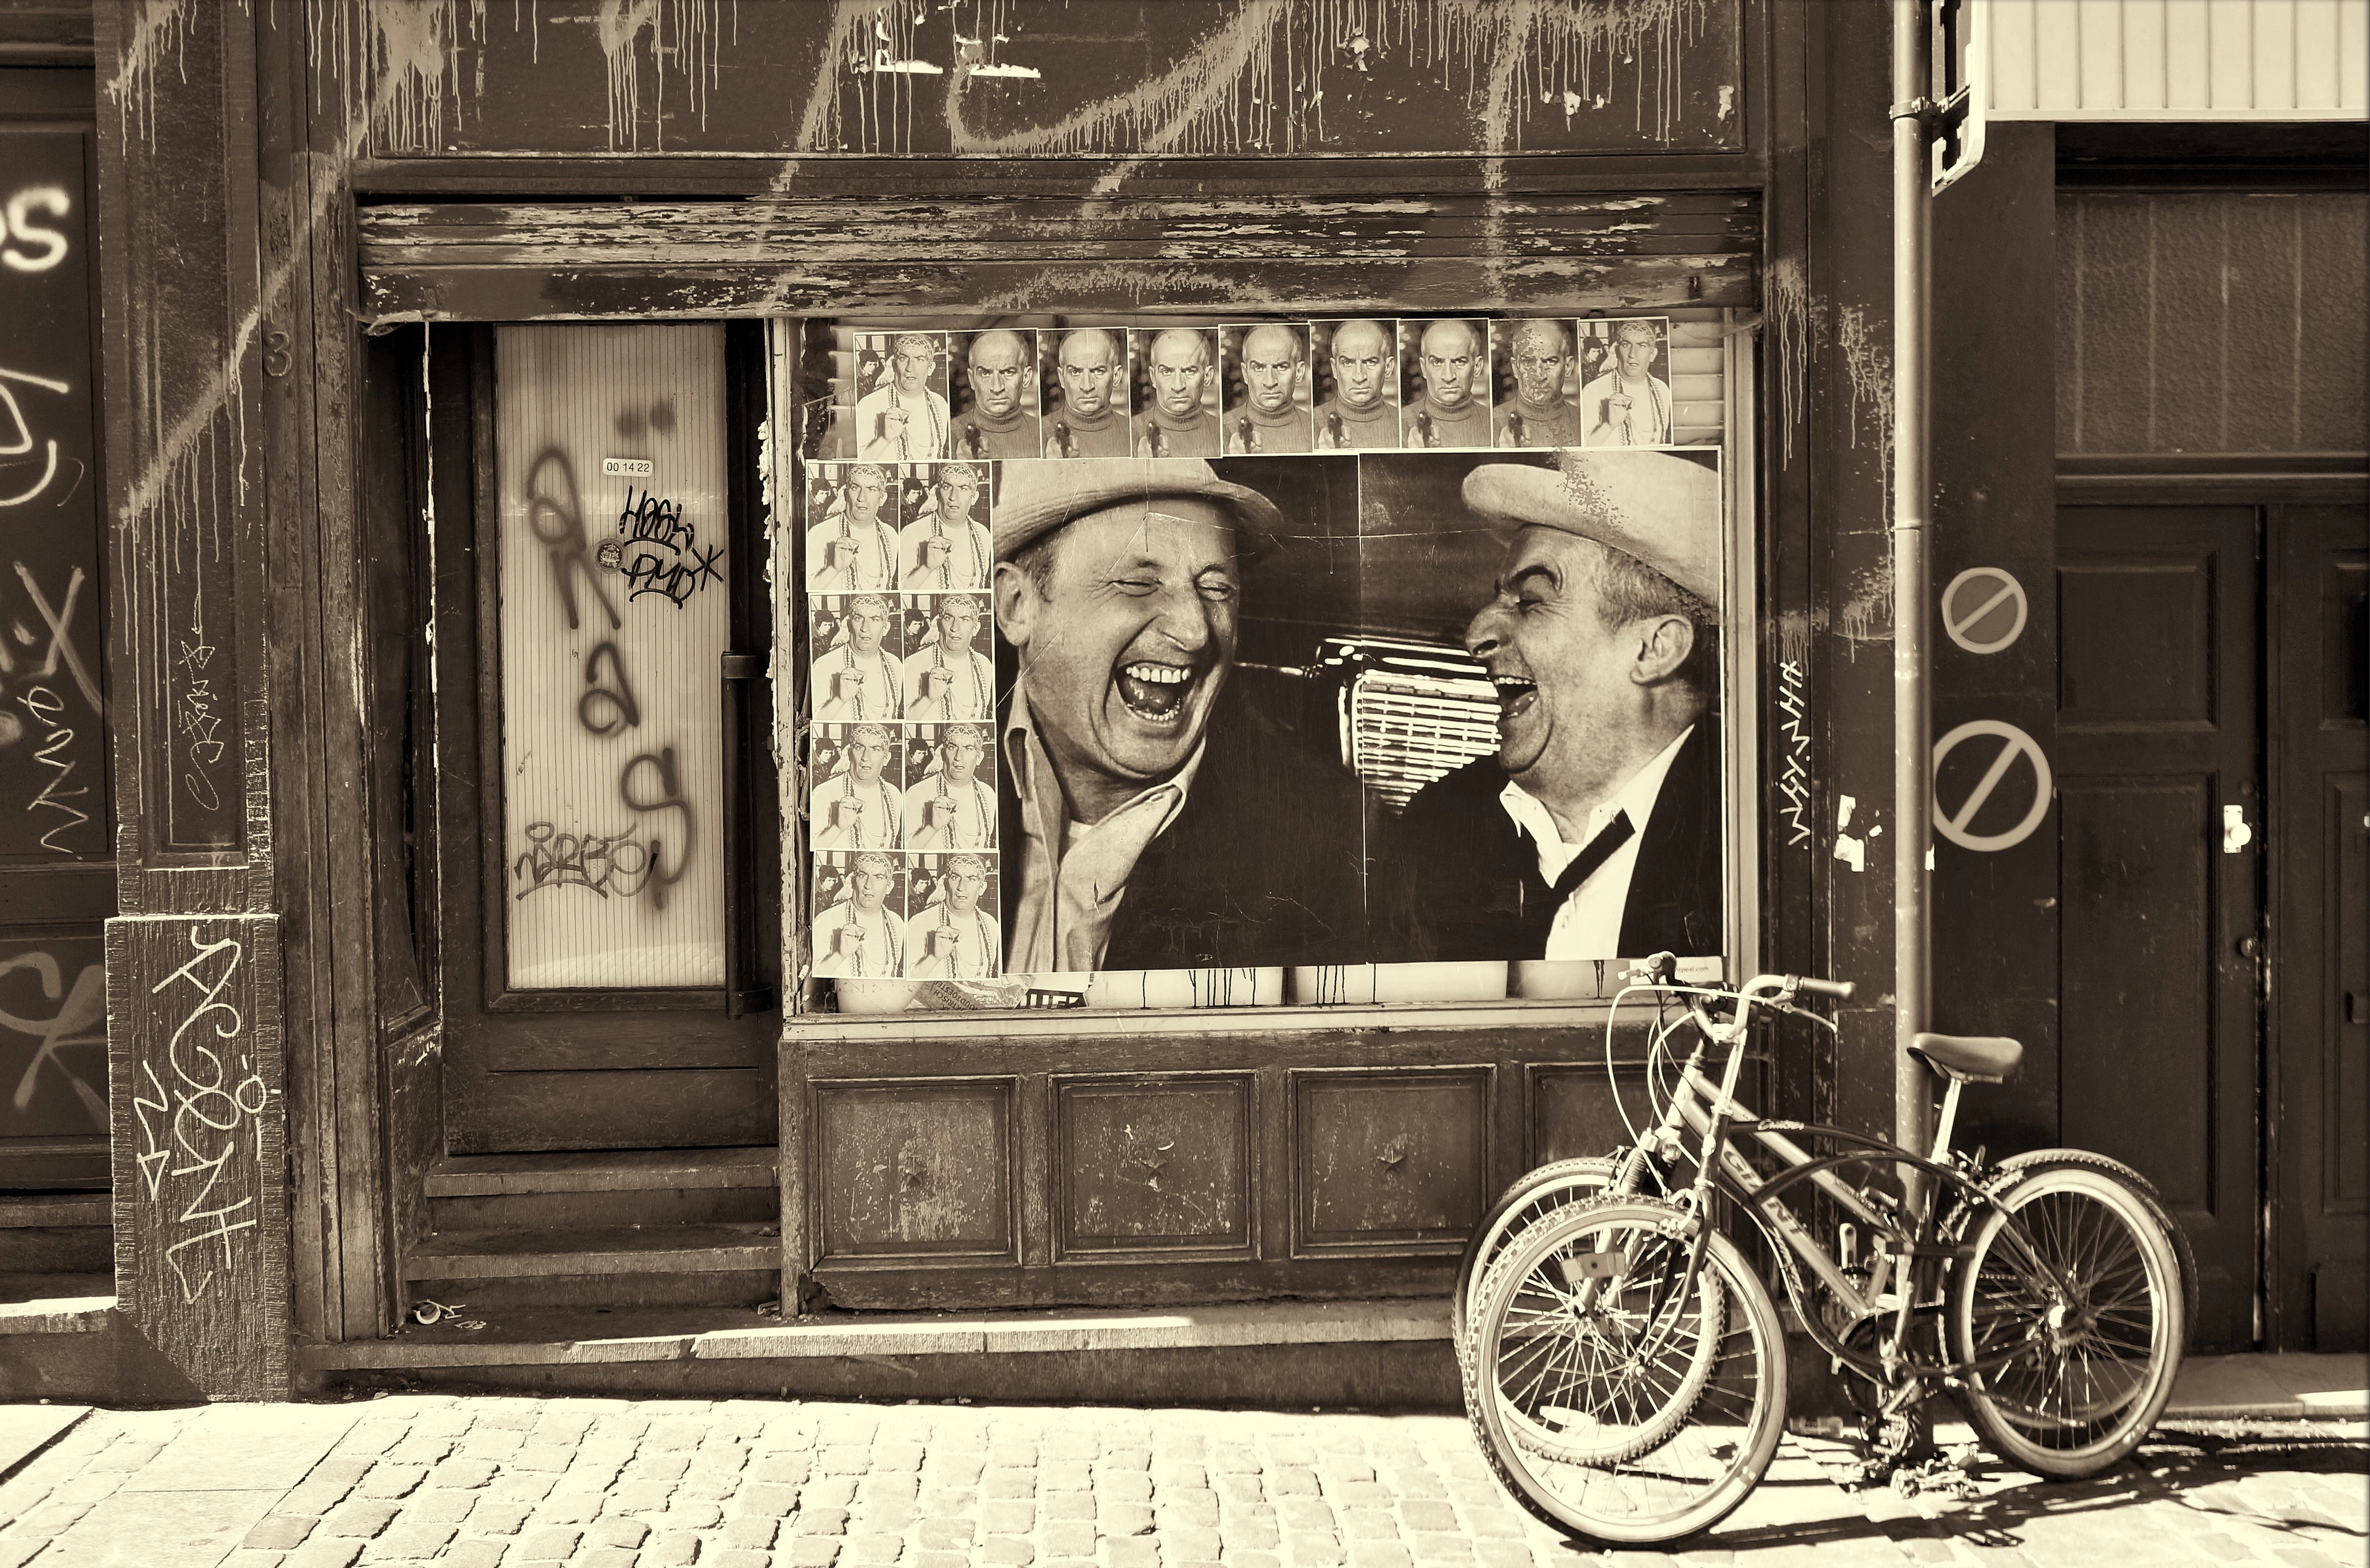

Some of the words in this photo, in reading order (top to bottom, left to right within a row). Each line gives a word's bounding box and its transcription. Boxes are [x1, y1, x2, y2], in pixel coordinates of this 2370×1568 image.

[0, 184, 71, 273] S
[607, 462, 619, 471] 00
[623, 462, 634, 472] 14
[637, 463, 650, 473] 22
[933, 989, 963, 1011] KTRISCH
[934, 981, 978, 1010] OUDTOESTE
[1724, 1151, 1810, 1240] GINT
